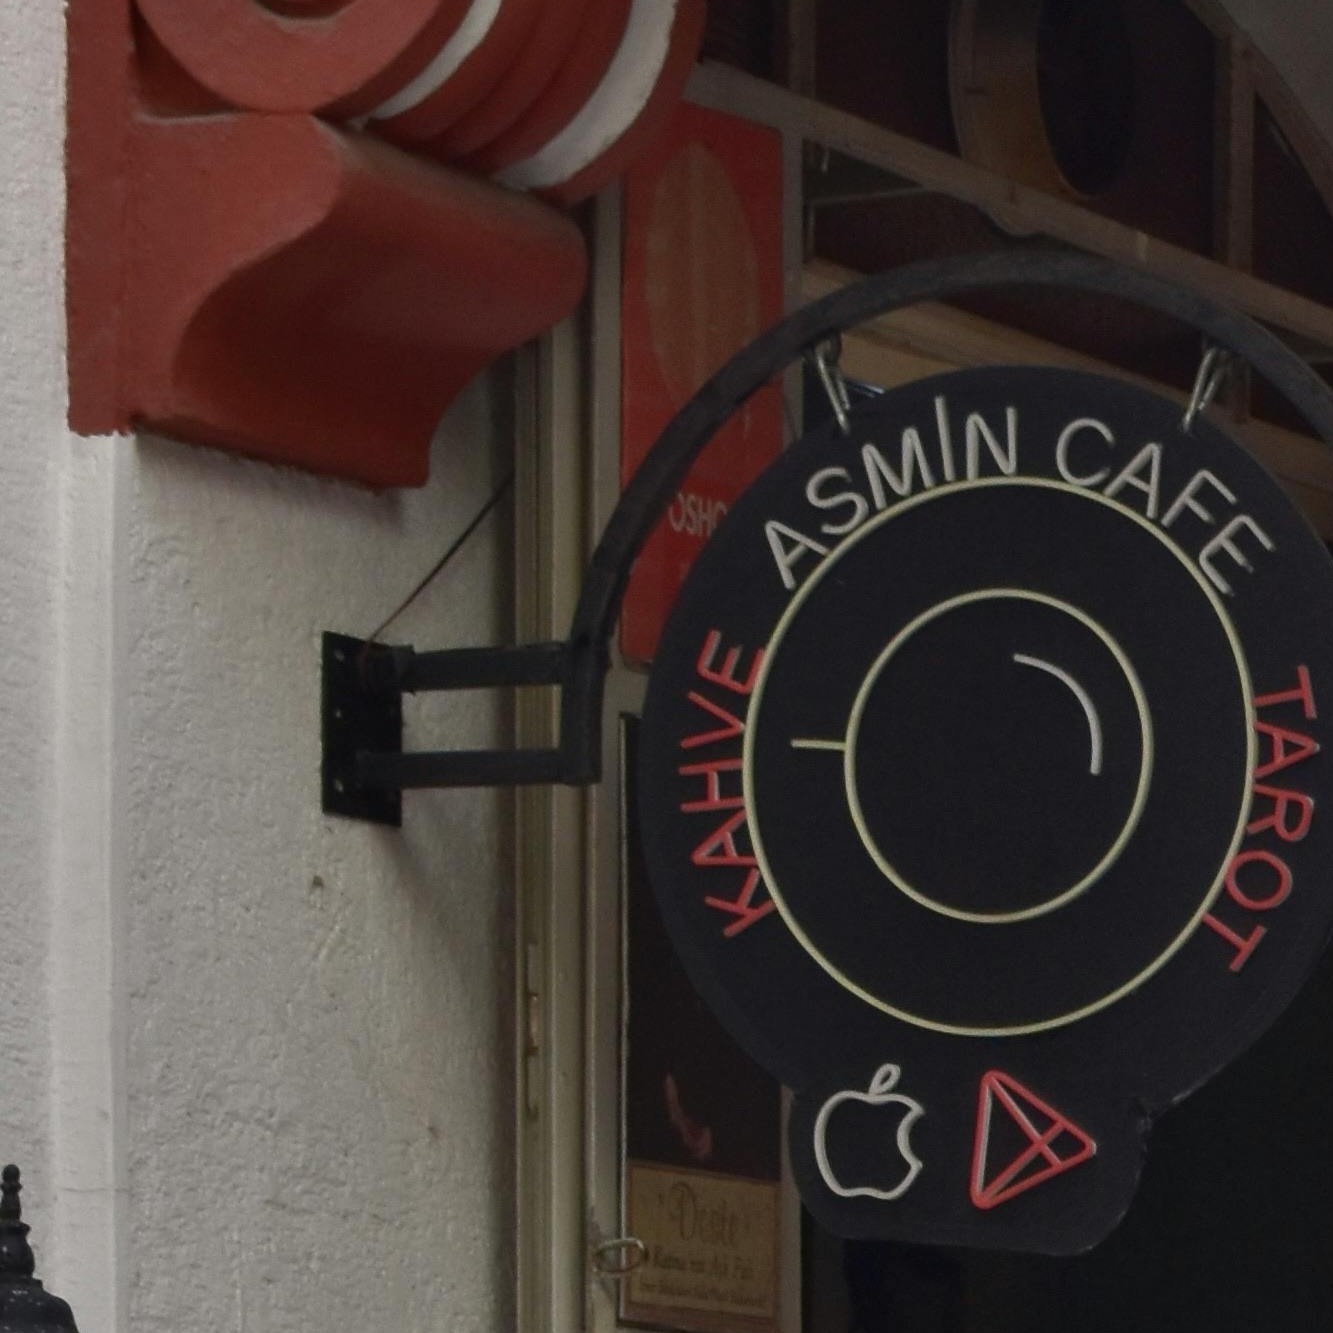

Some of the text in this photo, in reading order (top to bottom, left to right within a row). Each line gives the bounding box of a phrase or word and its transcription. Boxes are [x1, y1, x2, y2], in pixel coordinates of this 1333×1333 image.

[1055, 419, 1274, 597] CAFE
[680, 630, 775, 937] KAHVE
[1200, 665, 1319, 972] TAROT
